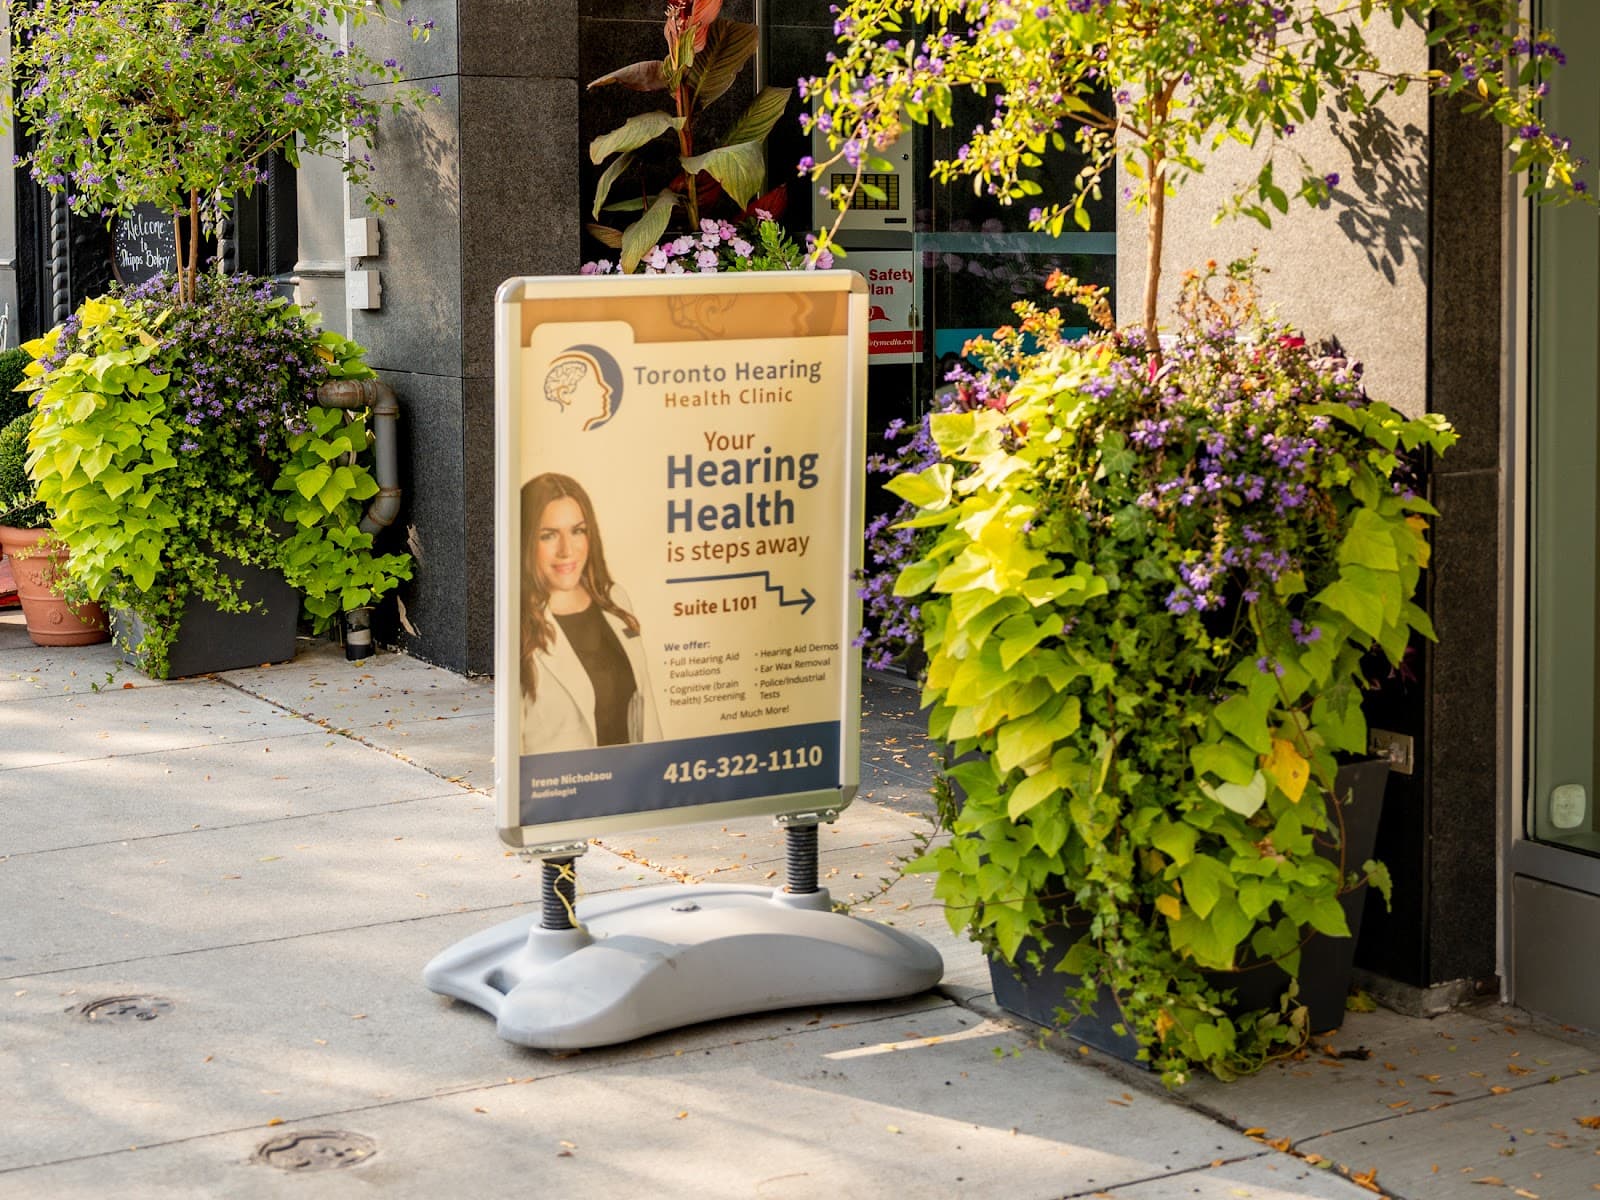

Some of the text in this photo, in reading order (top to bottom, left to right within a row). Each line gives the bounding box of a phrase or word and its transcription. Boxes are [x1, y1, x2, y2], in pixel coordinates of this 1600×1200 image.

[124, 210, 166, 240] Welcome
[140, 237, 148, 252] to
[120, 248, 170, 272] Phipps Bakery
[869, 268, 914, 283] Safety
[633, 360, 822, 385] Toronto Hearing
[665, 387, 793, 408] Health Clinic
[704, 431, 756, 451] Your
[667, 446, 819, 489] Hearing
[667, 490, 795, 534] Health
[667, 535, 810, 564] is steps away
[673, 596, 757, 617] Suite L101
[664, 640, 711, 652] We offer:
[760, 643, 839, 658] Hearing Aid Demos
[670, 652, 740, 666] Full Hearing Aid
[760, 658, 831, 673] Ear Wax Removal
[670, 667, 721, 679] Evaluations
[760, 672, 826, 688] Police/Industrial
[670, 684, 712, 696] Cognitive
[703, 691, 746, 704] Screening
[760, 690, 781, 700] Tests
[720, 705, 790, 721] And Much More!
[663, 745, 824, 784] 416-322-1110
[531, 777, 559, 789] Irene
